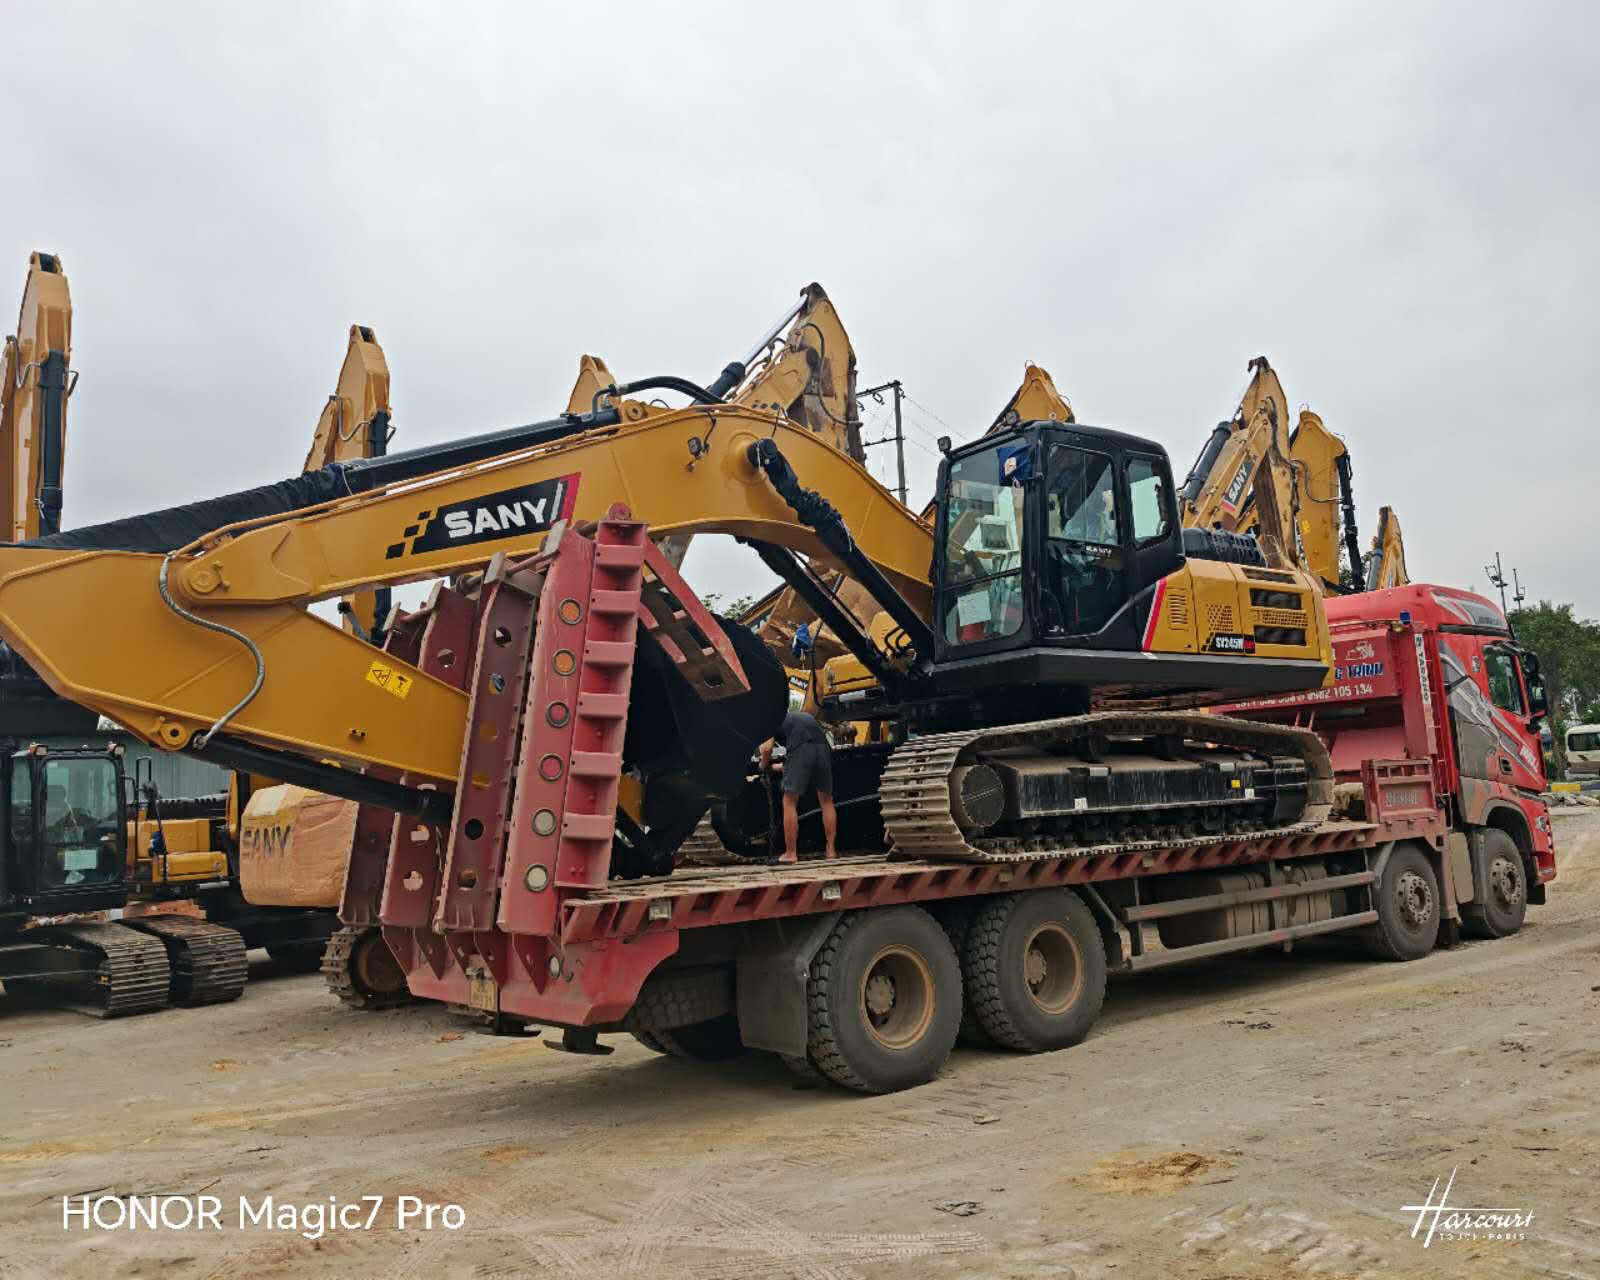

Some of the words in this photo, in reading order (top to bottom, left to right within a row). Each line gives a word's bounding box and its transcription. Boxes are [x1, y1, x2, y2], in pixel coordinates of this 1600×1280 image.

[1228, 463, 1248, 503] SANY
[444, 498, 547, 538] SANY
[1085, 545, 1112, 558] SANY
[1333, 685, 1352, 698] 105
[1354, 683, 1373, 696] 134
